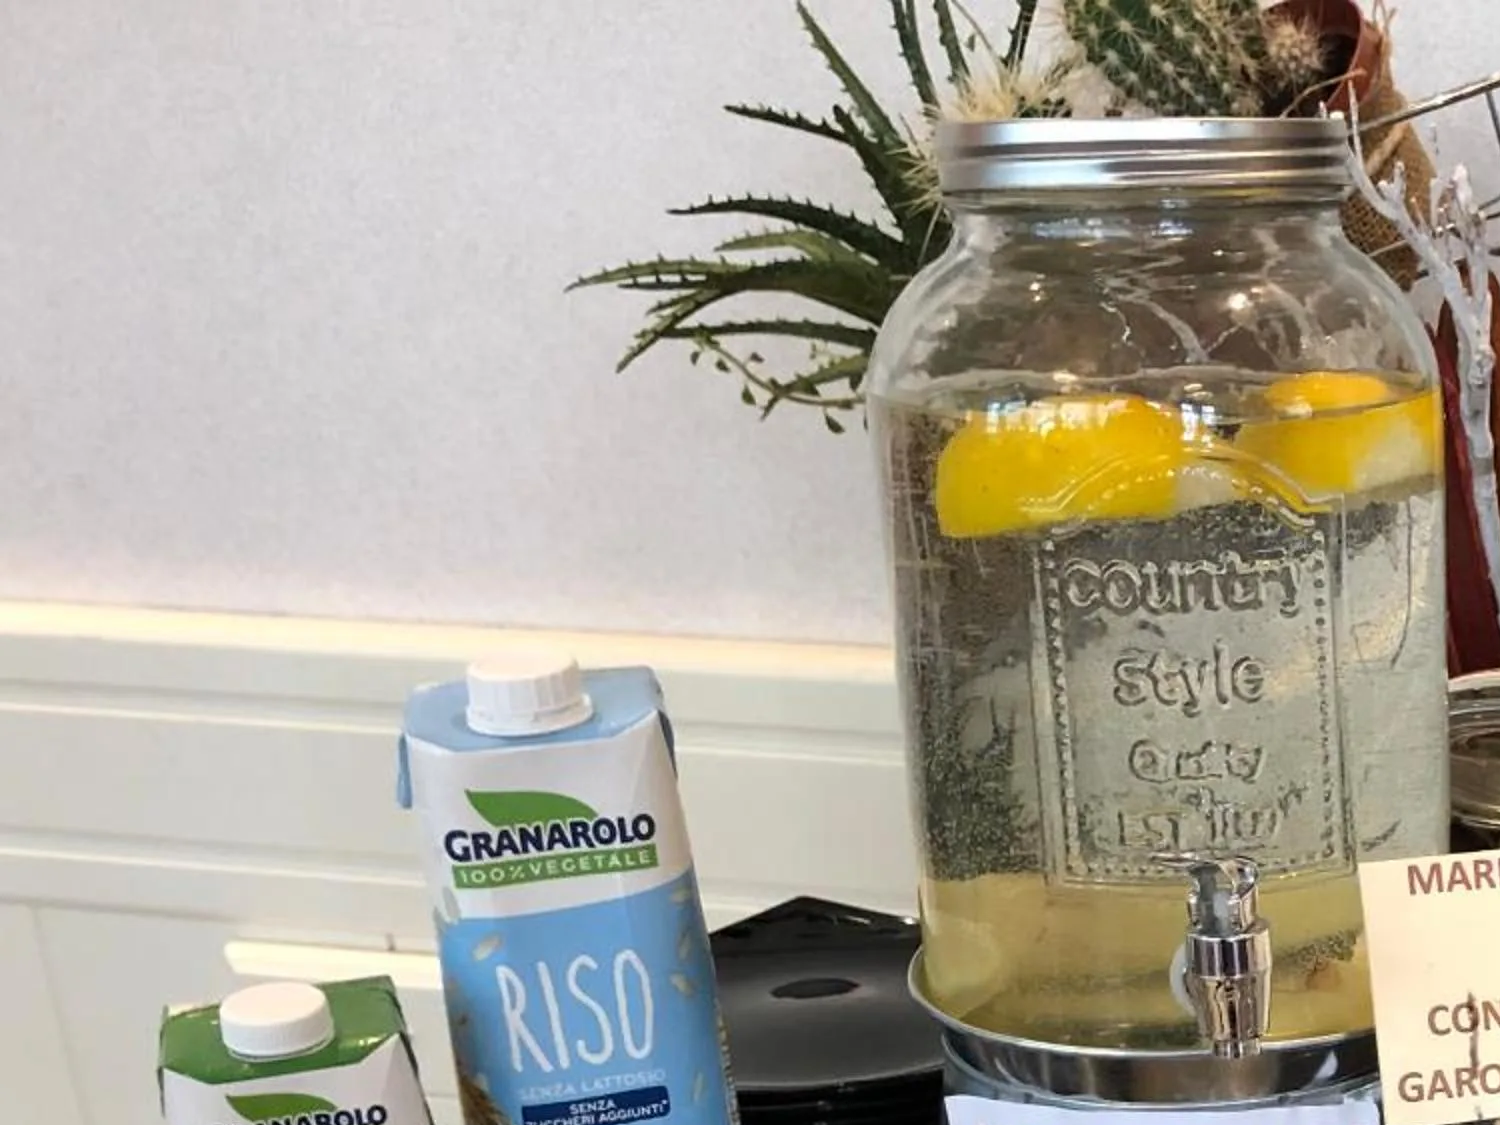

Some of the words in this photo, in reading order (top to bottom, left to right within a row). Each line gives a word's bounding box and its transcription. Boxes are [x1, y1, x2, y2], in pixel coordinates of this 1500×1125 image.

[445, 813, 656, 863] GRANAROLO
[496, 948, 655, 1073] RISO
[581, 1069, 665, 1092] LATTOSIO
[569, 1099, 616, 1115] SENZA
